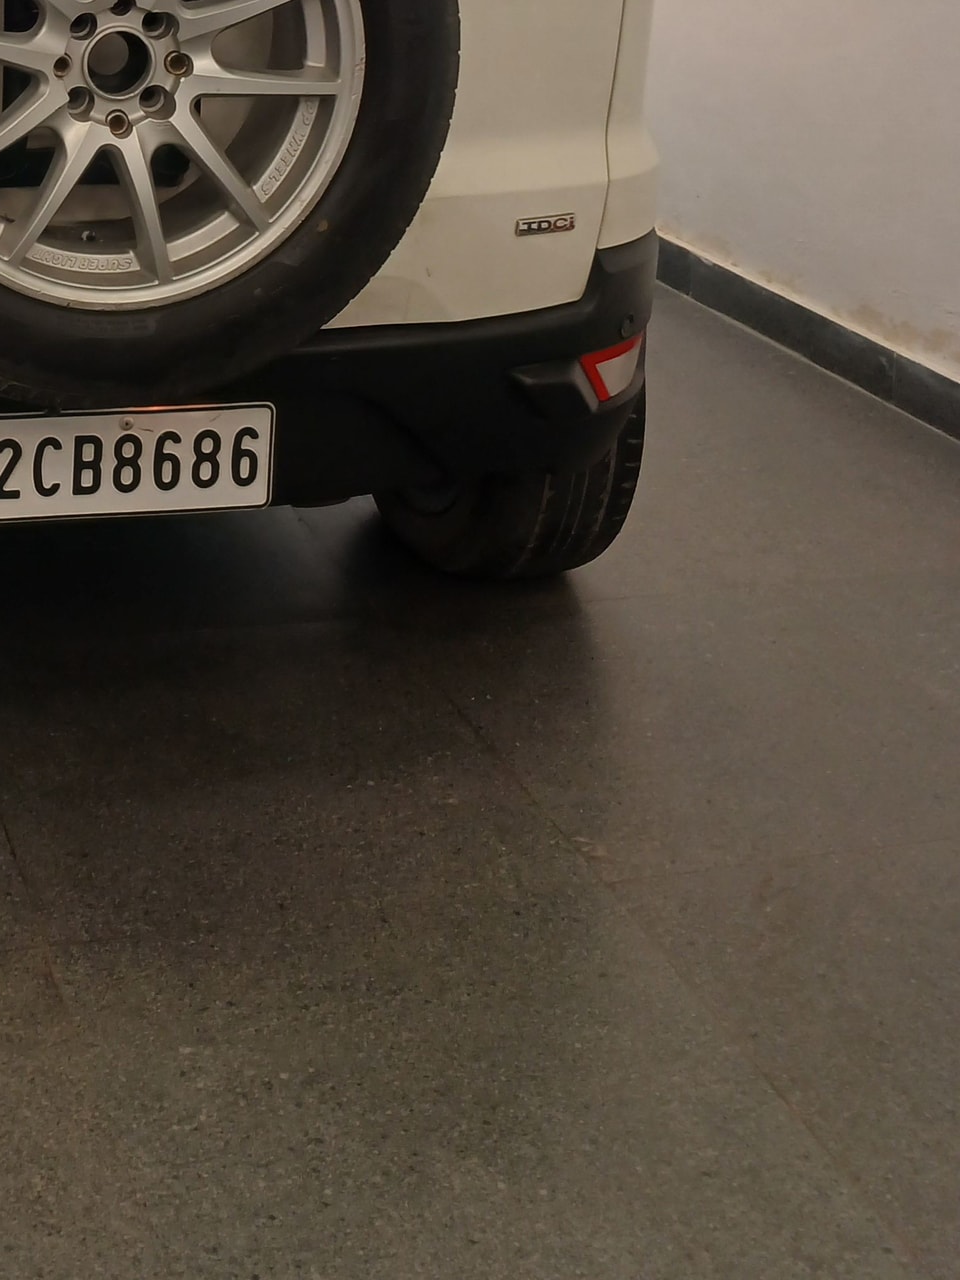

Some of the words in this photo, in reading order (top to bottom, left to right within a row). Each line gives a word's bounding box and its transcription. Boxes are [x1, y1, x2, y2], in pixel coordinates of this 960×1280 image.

[261, 129, 306, 196] WHEELS
[31, 250, 78, 268] LIGHT
[79, 257, 134, 271] SUPER
